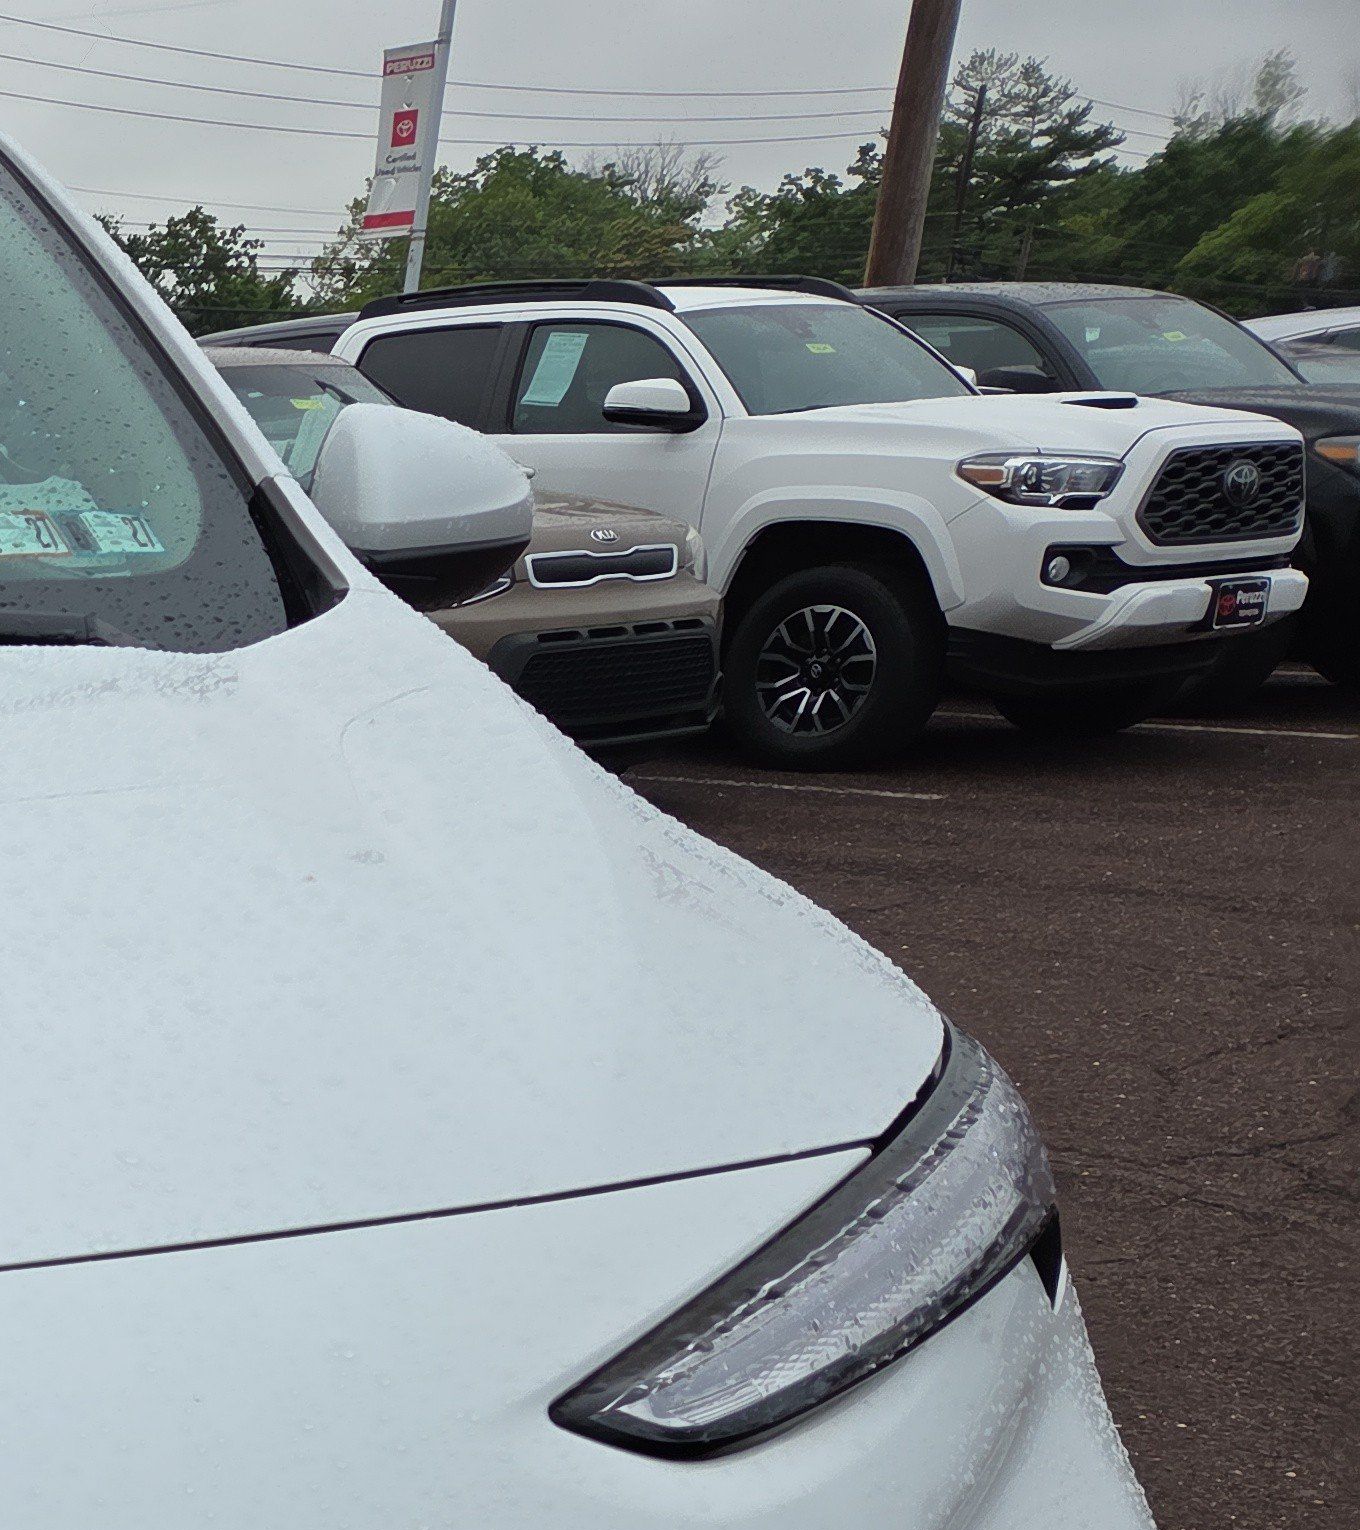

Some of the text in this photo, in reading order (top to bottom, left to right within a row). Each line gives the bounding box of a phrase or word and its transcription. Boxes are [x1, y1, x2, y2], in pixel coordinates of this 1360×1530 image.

[386, 56, 432, 74] PERUZZI
[24, 516, 60, 550] 27
[120, 516, 157, 549] 27
